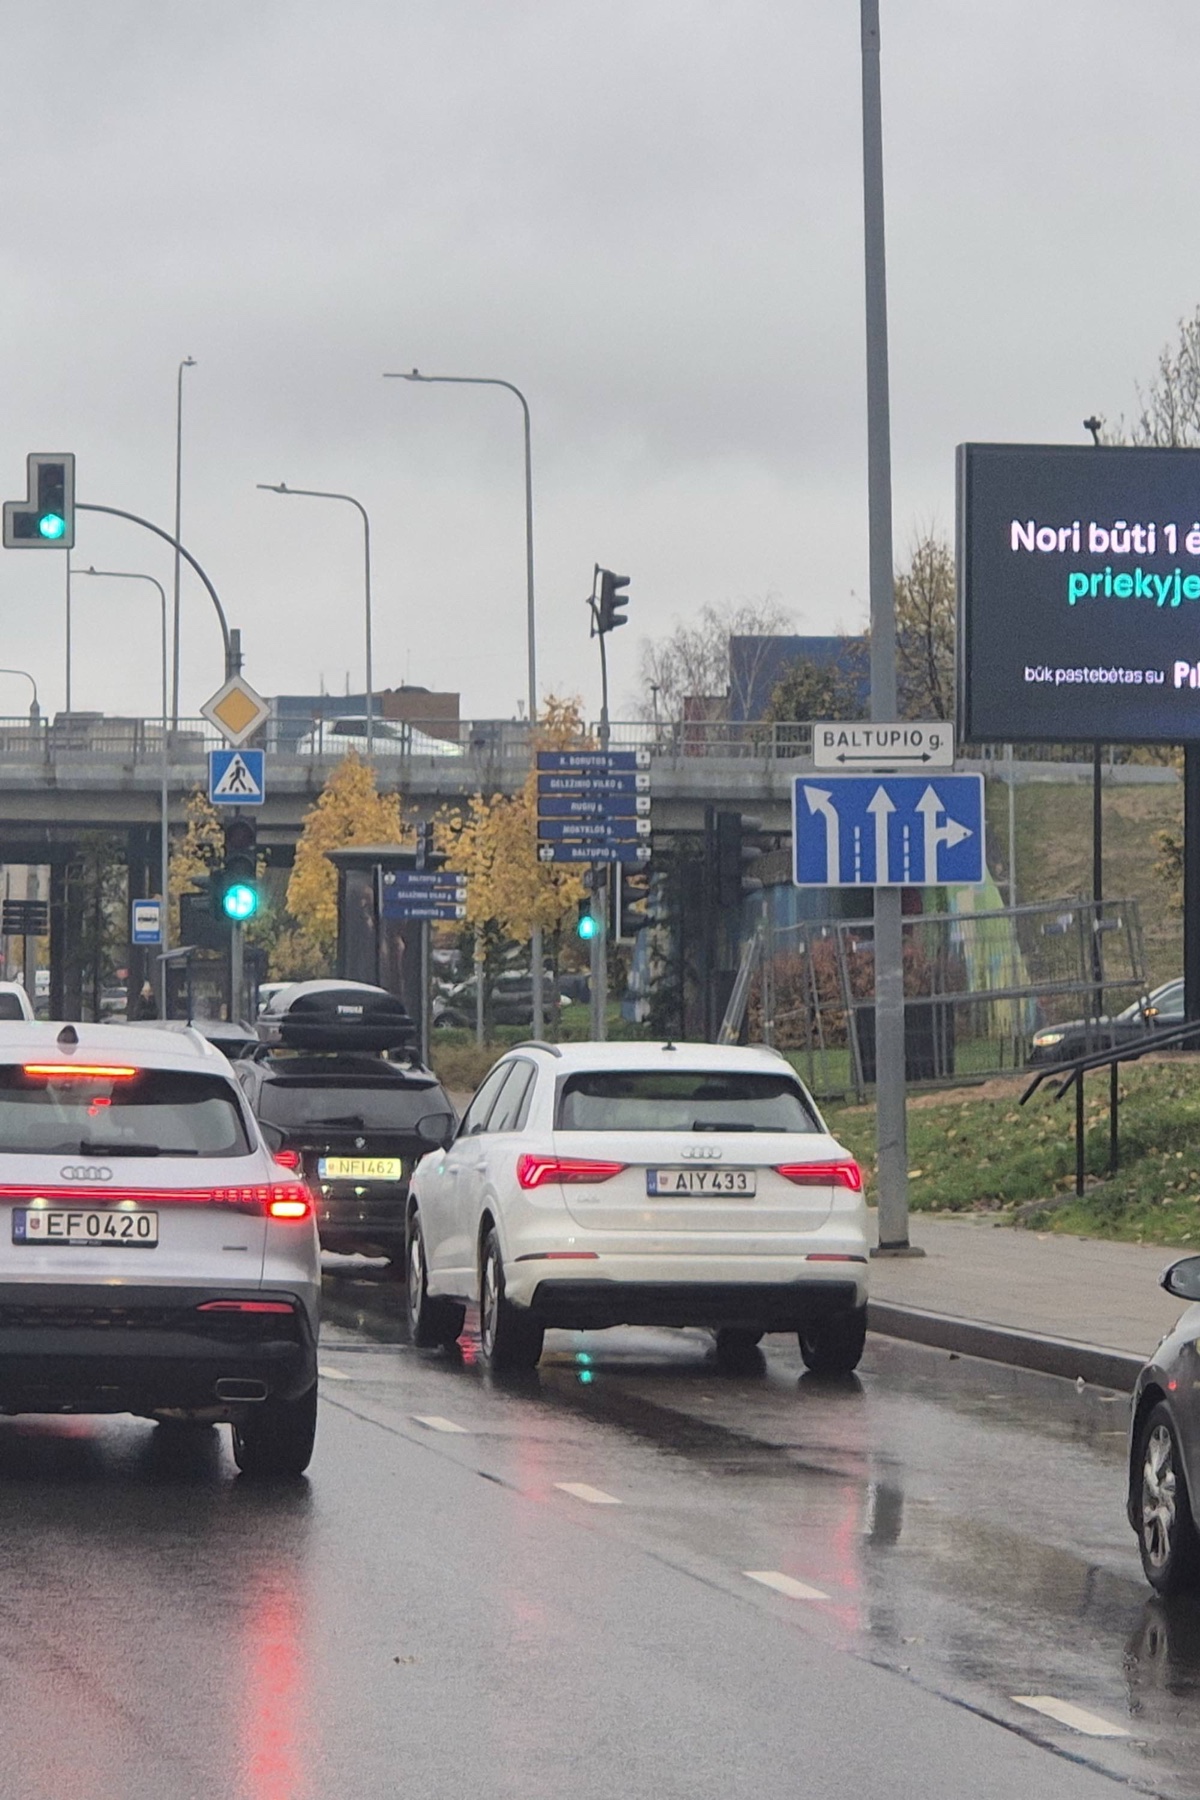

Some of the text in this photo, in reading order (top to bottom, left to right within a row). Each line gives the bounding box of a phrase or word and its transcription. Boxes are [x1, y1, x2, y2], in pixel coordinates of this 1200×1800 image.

[1011, 520, 1081, 553] Nori
[1089, 520, 1156, 554] būti
[1164, 523, 1177, 555] 1
[1024, 666, 1053, 683] būk
[1055, 667, 1142, 686] pastebėtas
[1145, 669, 1165, 684] su
[823, 729, 944, 751] BALTUPIO g.
